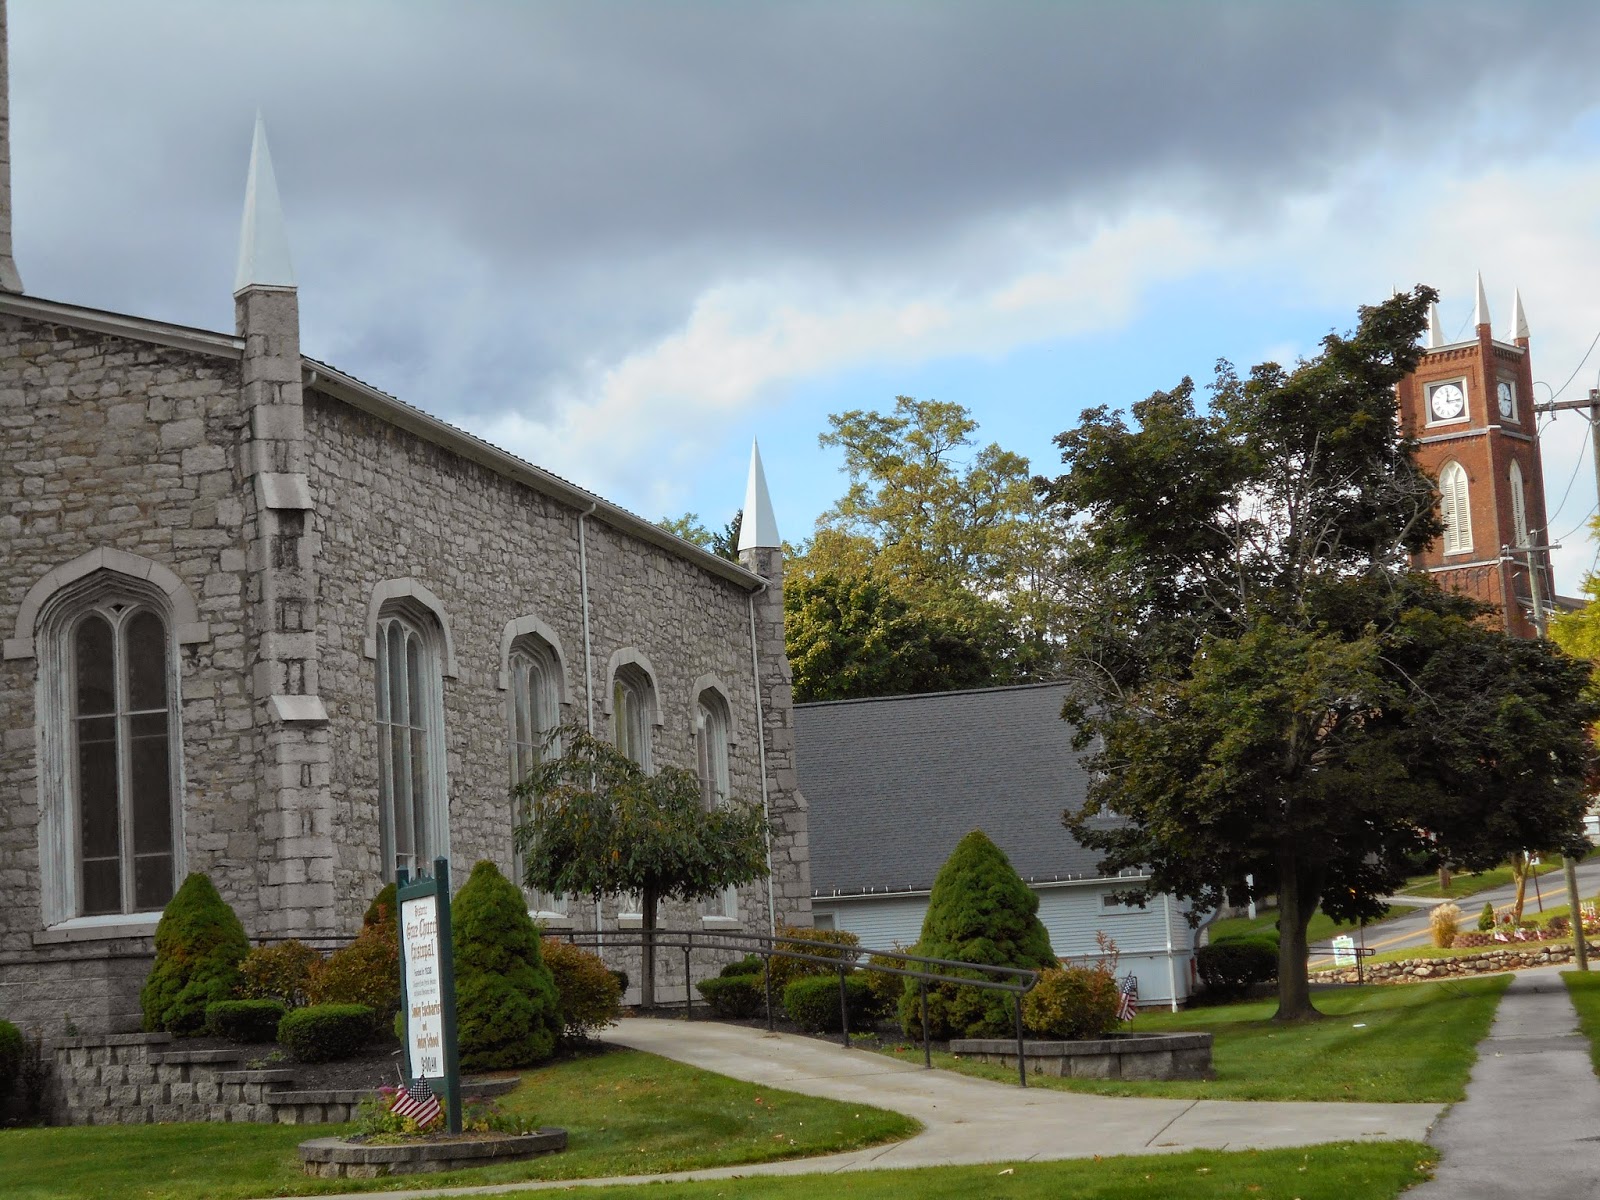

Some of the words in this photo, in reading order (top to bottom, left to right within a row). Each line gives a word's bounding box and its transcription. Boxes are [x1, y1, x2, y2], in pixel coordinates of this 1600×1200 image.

[410, 938, 435, 964] Episcopal
[421, 1000, 441, 1017] Eucharis
[426, 1031, 440, 1049] School
